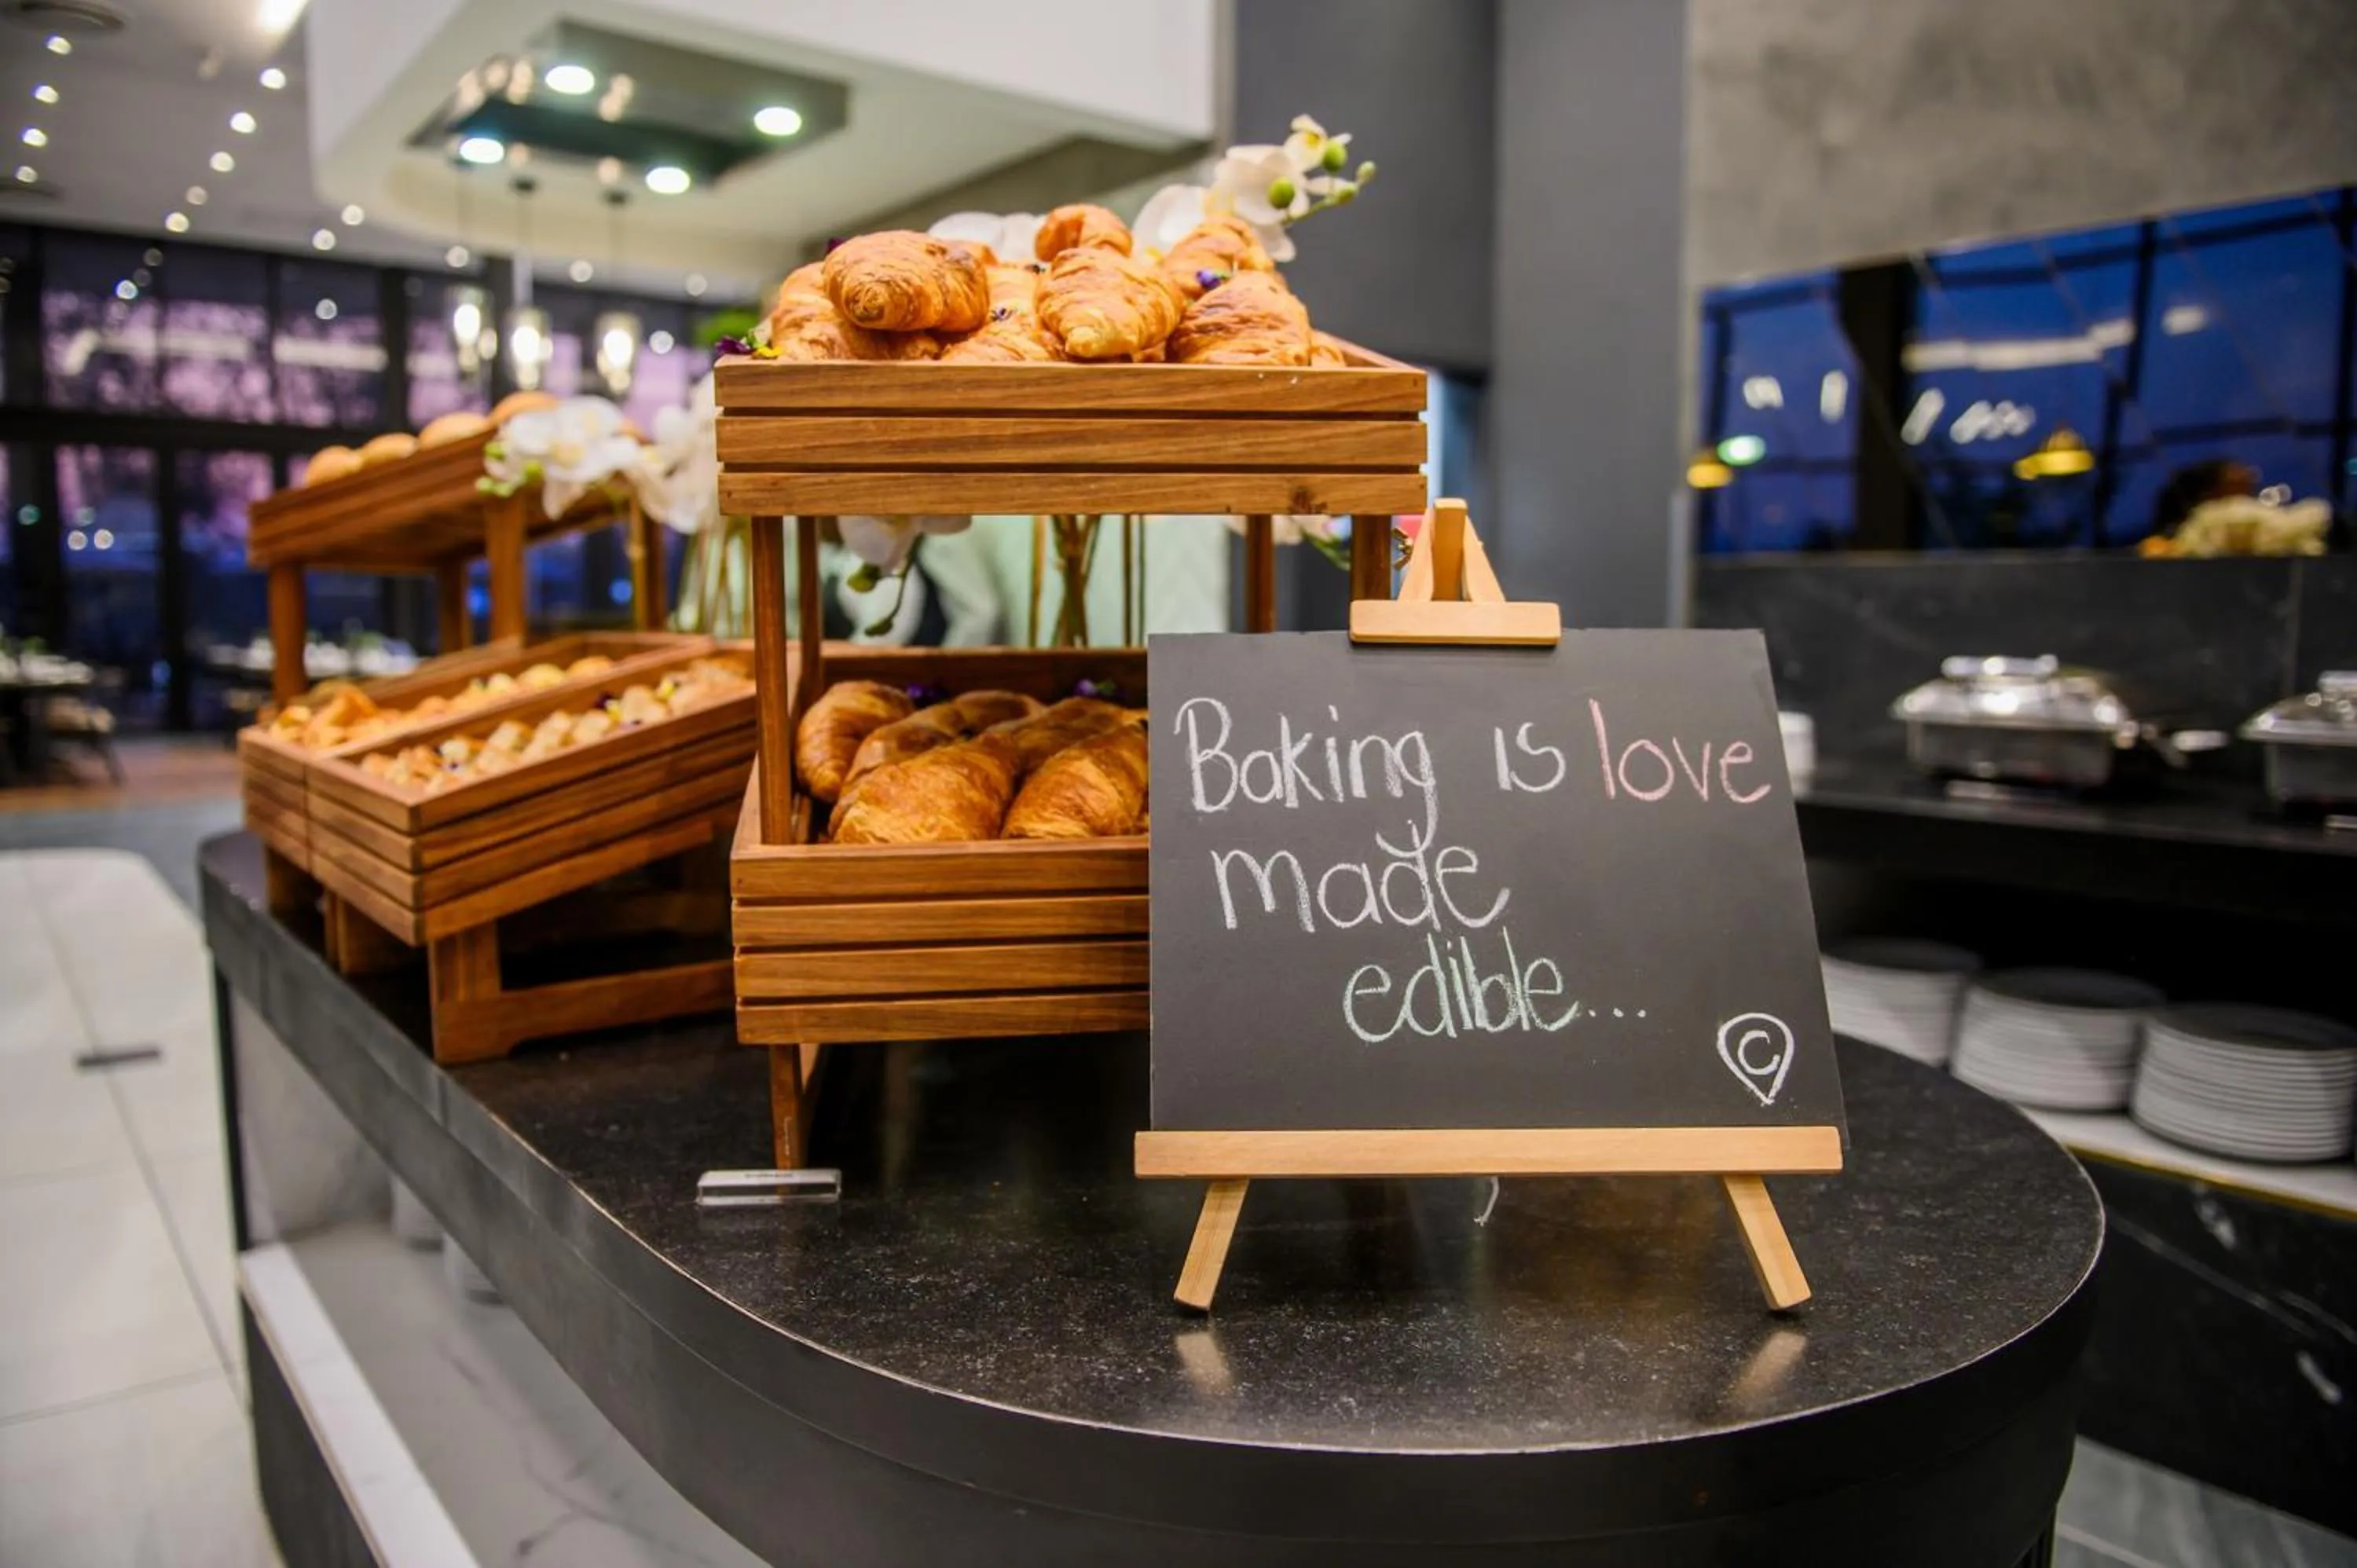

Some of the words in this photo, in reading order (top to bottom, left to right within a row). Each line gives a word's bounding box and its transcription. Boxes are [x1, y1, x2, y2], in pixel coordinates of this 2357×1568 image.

[1175, 698, 1439, 857] Baking
[1494, 721, 1566, 793] is
[1589, 698, 1772, 803] love
[1211, 820, 1511, 932] made
[1343, 927, 1647, 1043] edible...
